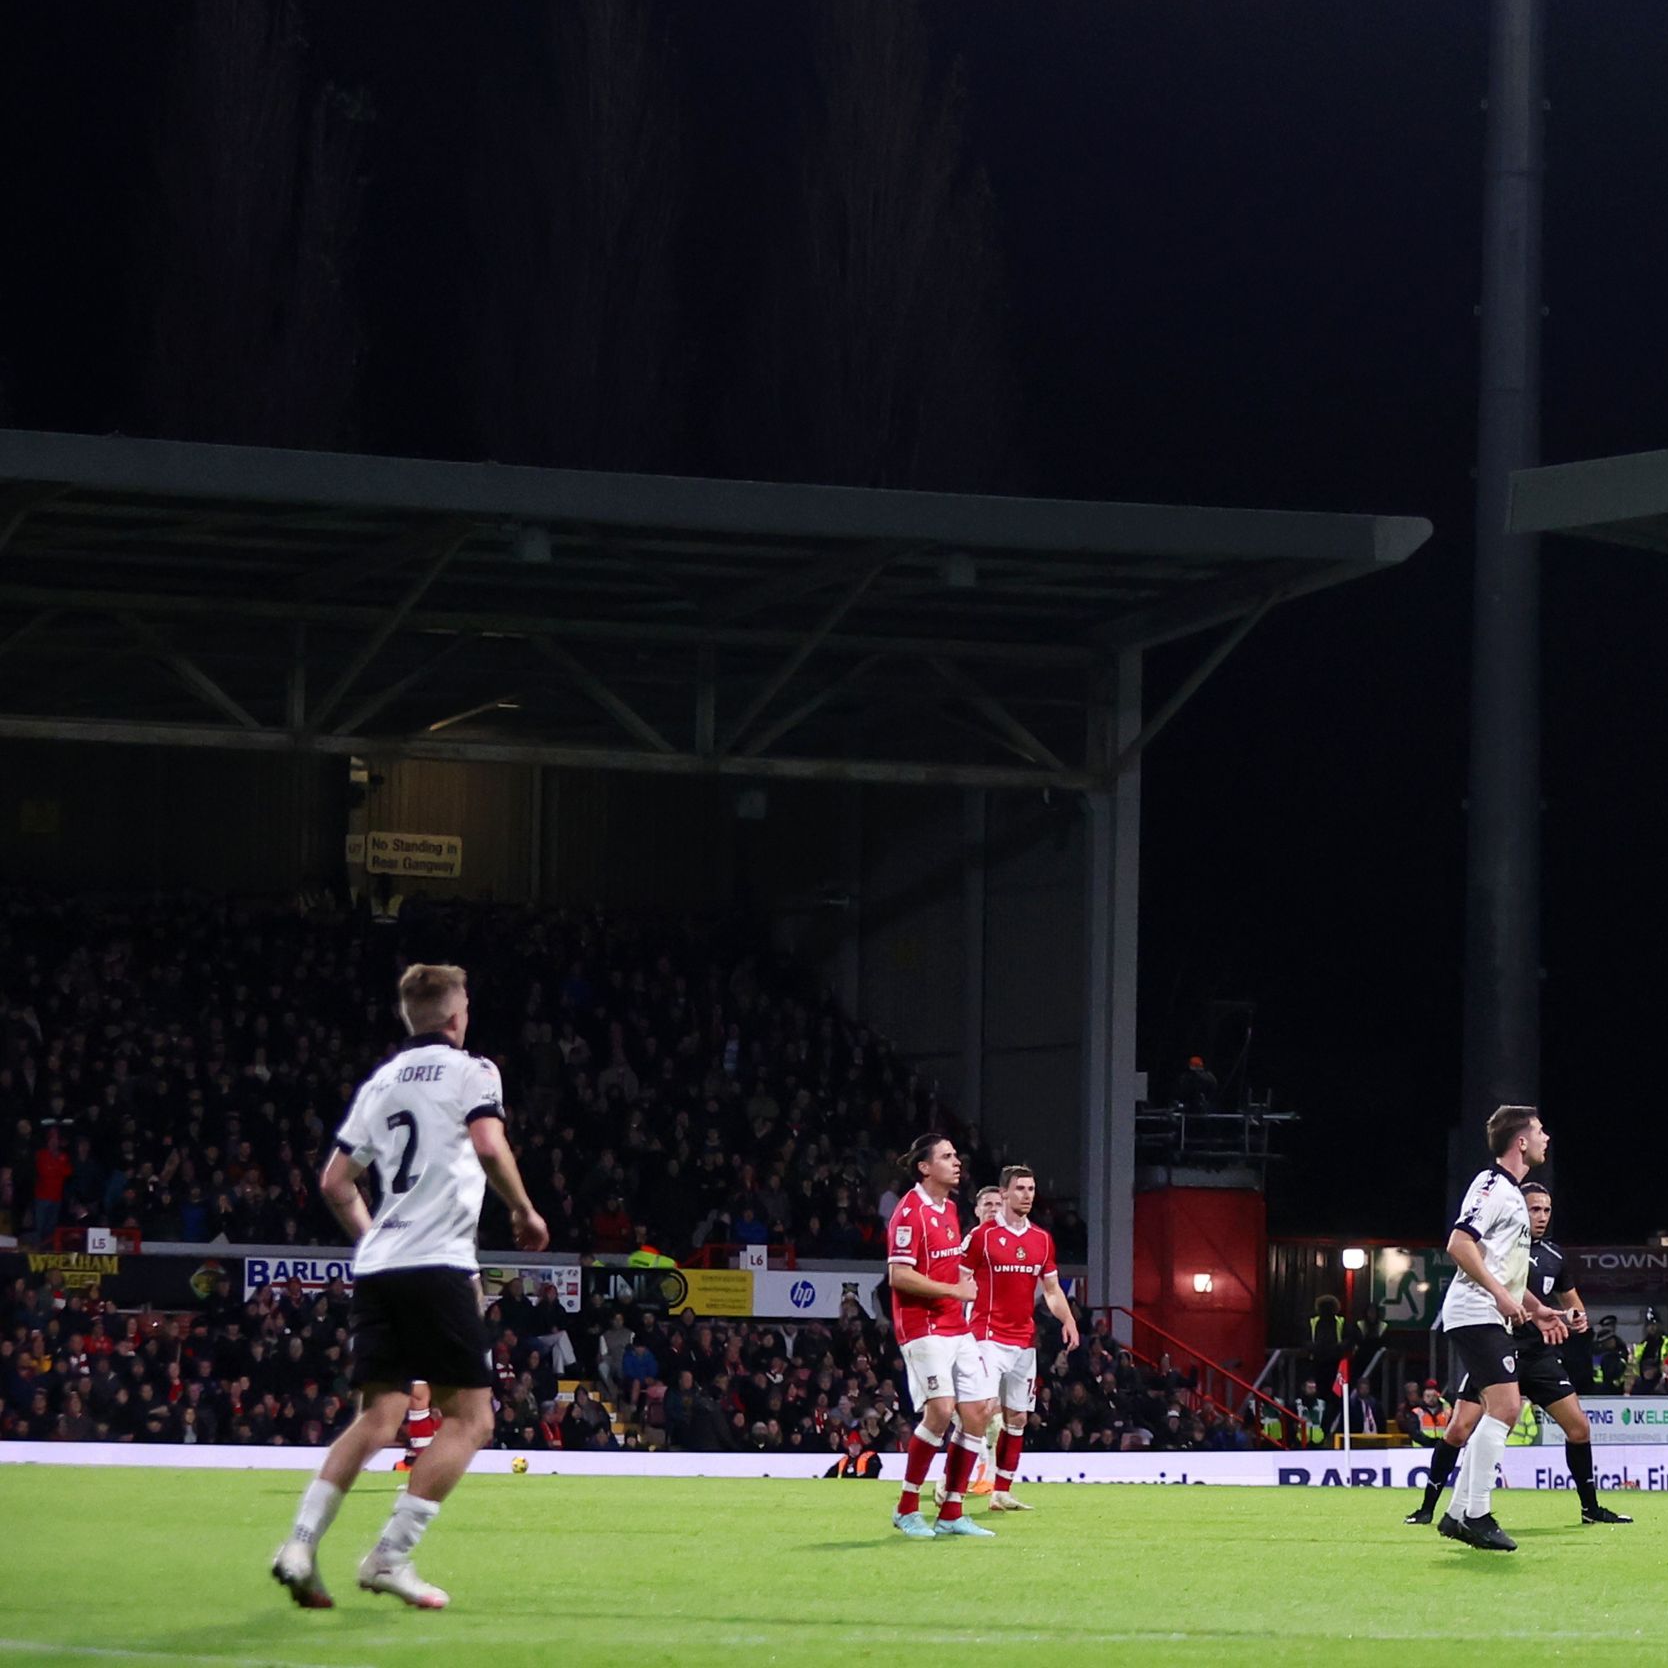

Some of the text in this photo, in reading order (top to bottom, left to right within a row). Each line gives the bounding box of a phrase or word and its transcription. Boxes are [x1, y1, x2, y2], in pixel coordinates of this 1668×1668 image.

[372, 837, 388, 850] No
[393, 838, 442, 855] Standing
[372, 855, 455, 873] Rear Gangway
[386, 1110, 420, 1194] 2
[750, 1255, 764, 1266] L6
[994, 1264, 1034, 1273] UNITED
[1580, 1253, 1668, 1269] TOWN
[792, 1281, 815, 1309] hp
